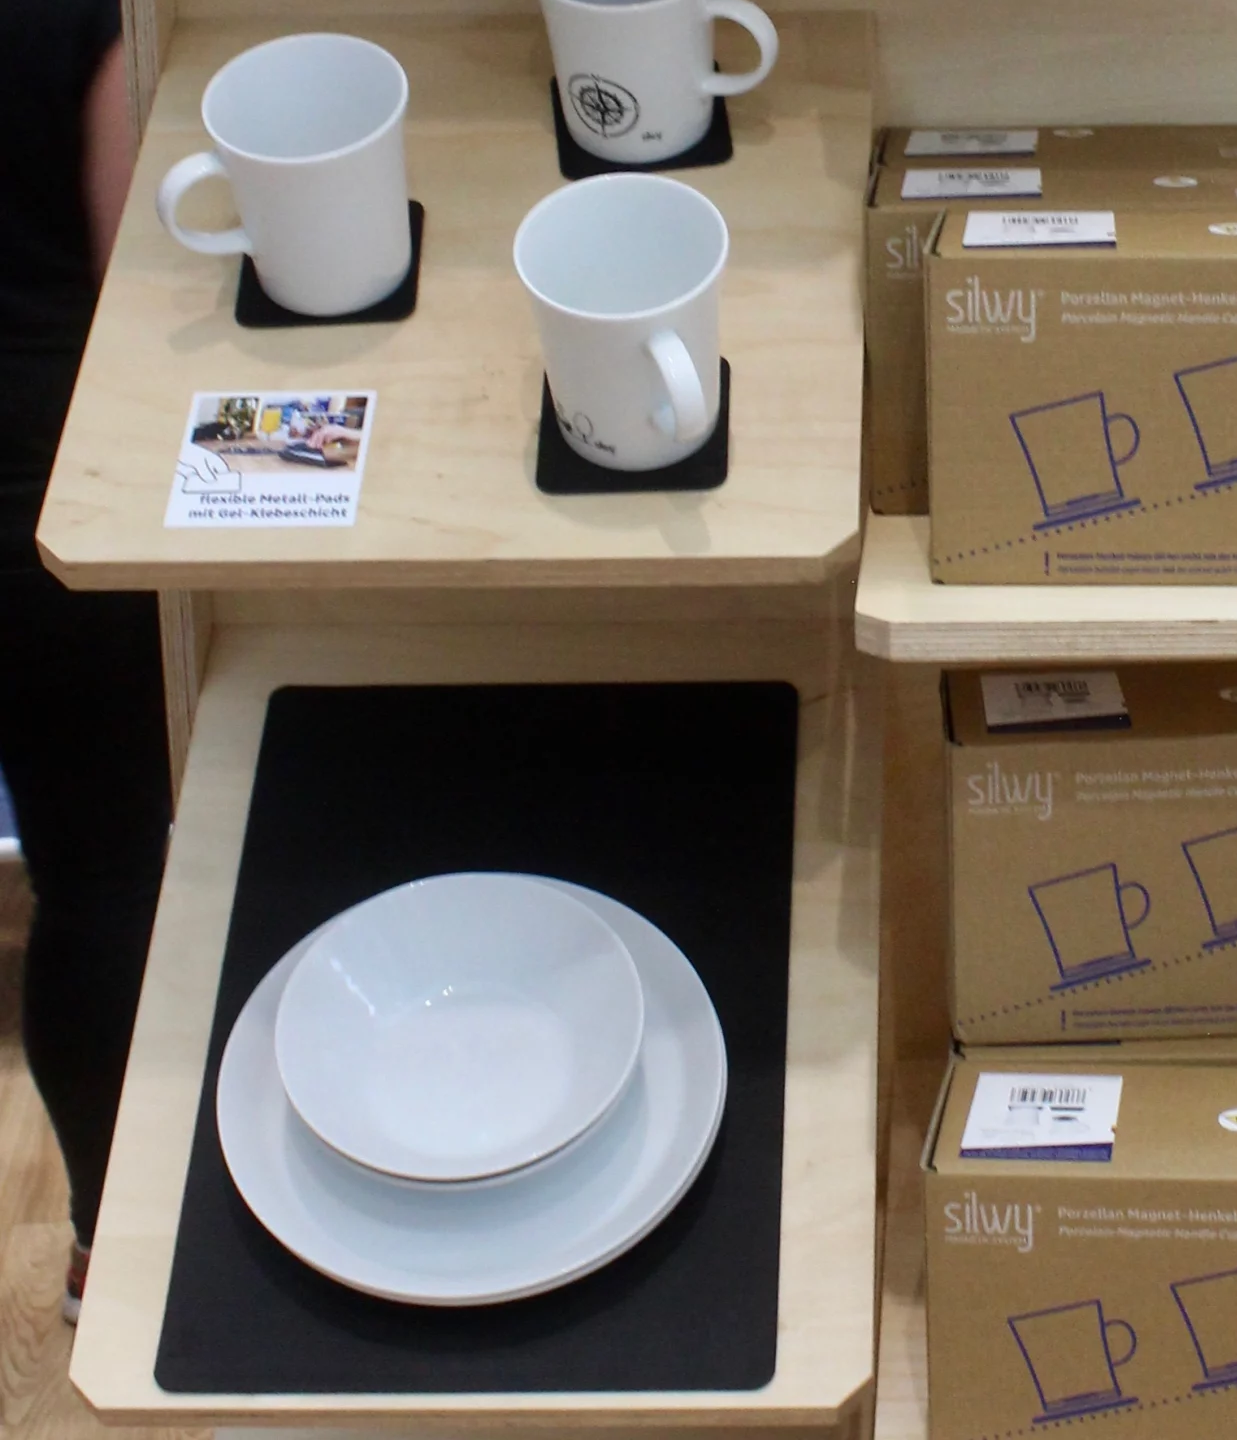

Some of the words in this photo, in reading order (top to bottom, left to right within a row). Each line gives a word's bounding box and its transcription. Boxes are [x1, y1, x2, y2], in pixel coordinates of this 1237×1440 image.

[885, 221, 921, 270] sil
[945, 275, 1037, 343] silwy
[966, 761, 1053, 821] silwy
[943, 1191, 1034, 1253] silwy
